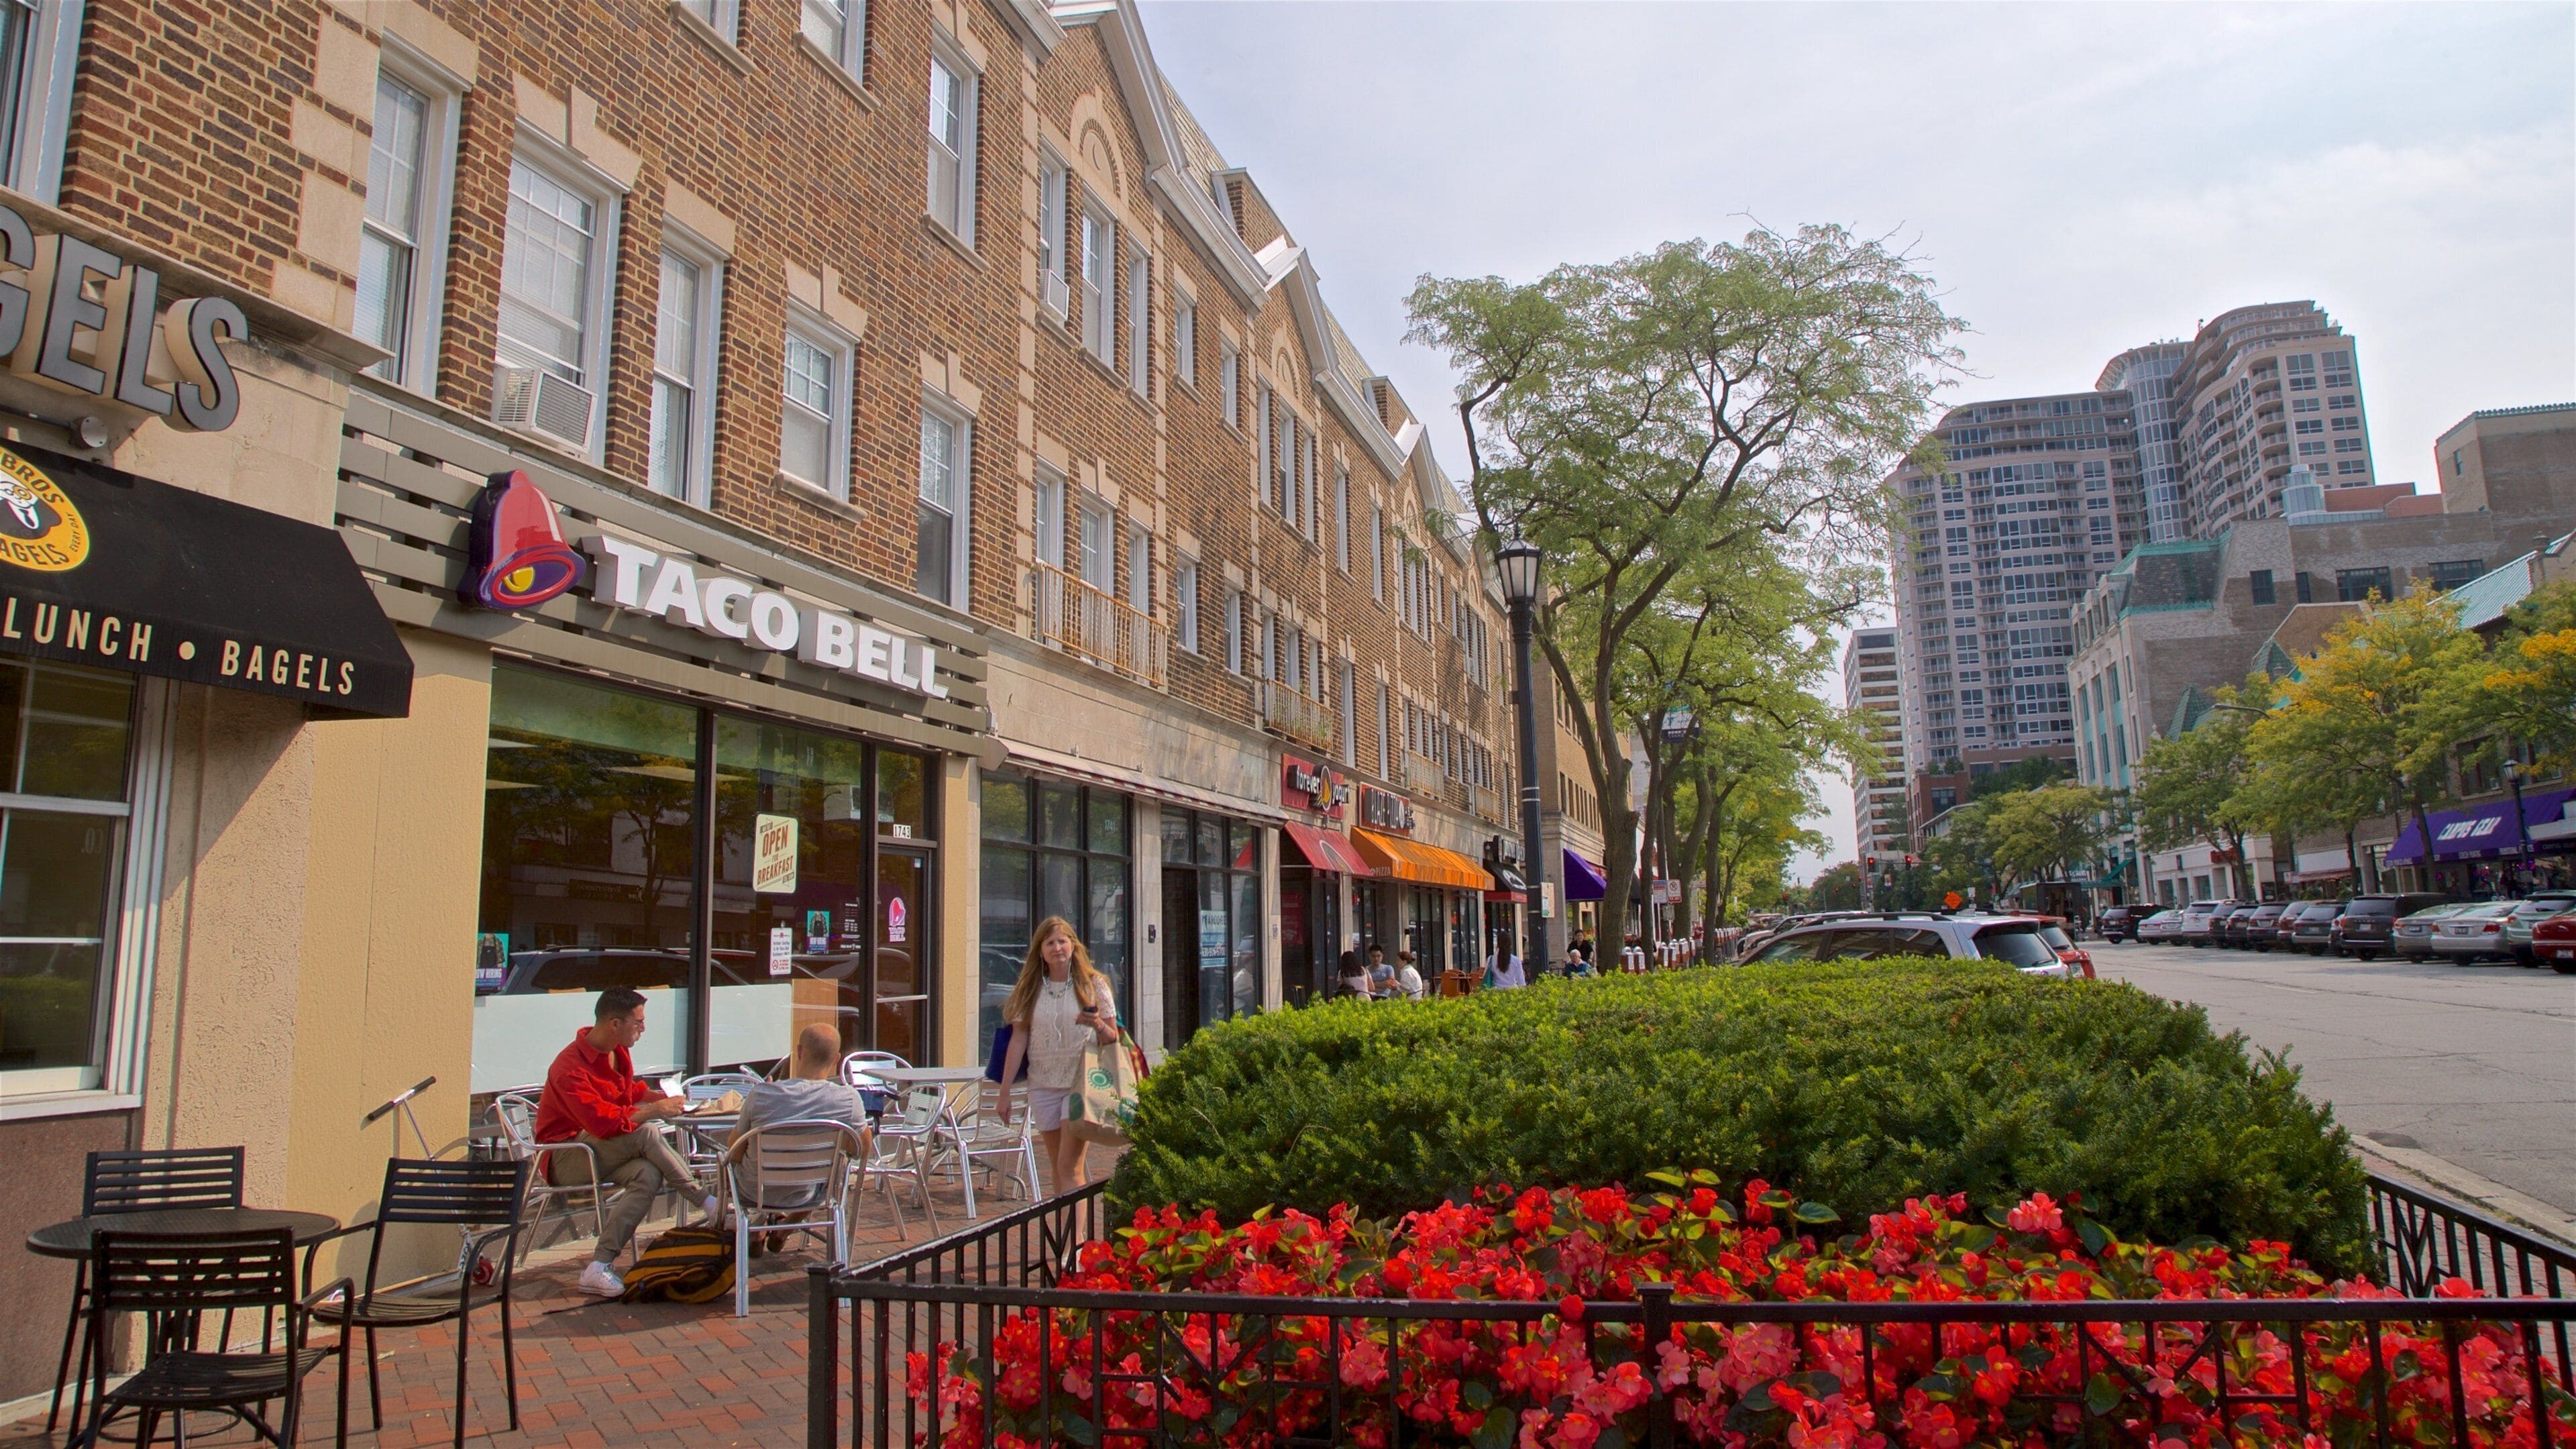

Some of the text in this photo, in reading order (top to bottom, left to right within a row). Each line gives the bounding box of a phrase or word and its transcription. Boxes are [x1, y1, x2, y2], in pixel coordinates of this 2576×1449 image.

[1, 452, 64, 504] BROS
[66, 512, 81, 552] EVERY DAY
[599, 535, 949, 698] TACO BELL
[3, 597, 355, 696] LUNCH BAGELS
[1297, 765, 1350, 806] forever yogurt
[763, 824, 789, 858] OPEN
[895, 826, 910, 838] 1743
[2437, 816, 2502, 840] CAMPUS GEAR
[757, 855, 794, 885] BREAKFAST
[1375, 867, 1391, 875] PIZZA
[889, 926, 906, 934] TACO
[890, 933, 906, 942] BELL
